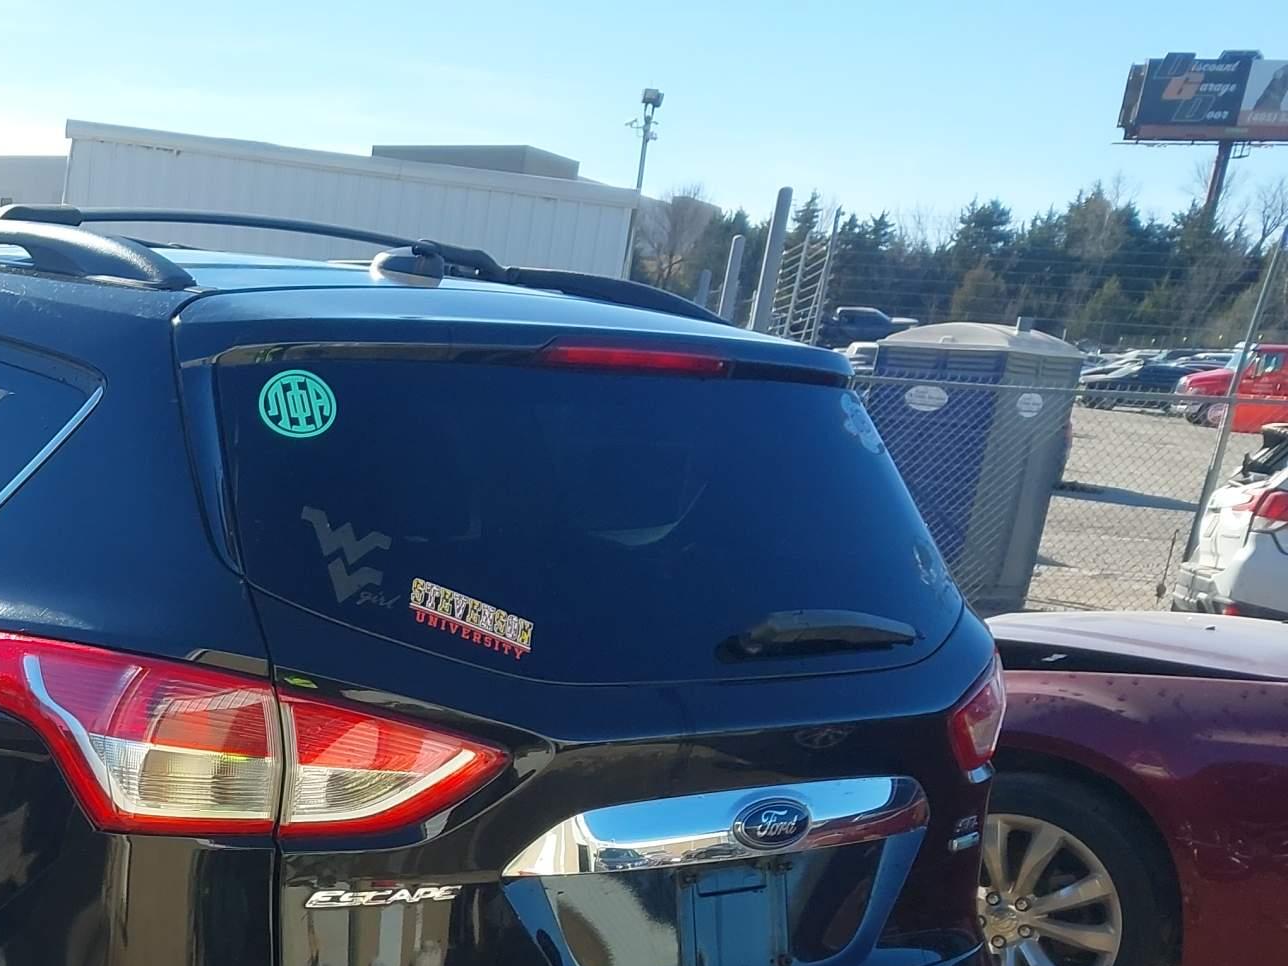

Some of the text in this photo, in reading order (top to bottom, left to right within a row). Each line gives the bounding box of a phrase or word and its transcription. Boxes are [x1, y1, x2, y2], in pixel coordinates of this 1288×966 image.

[411, 578, 533, 646] STEVENSON
[415, 610, 524, 660] UNIVERSITY
[757, 809, 799, 838] Ford
[305, 885, 463, 908] ESCAPE
